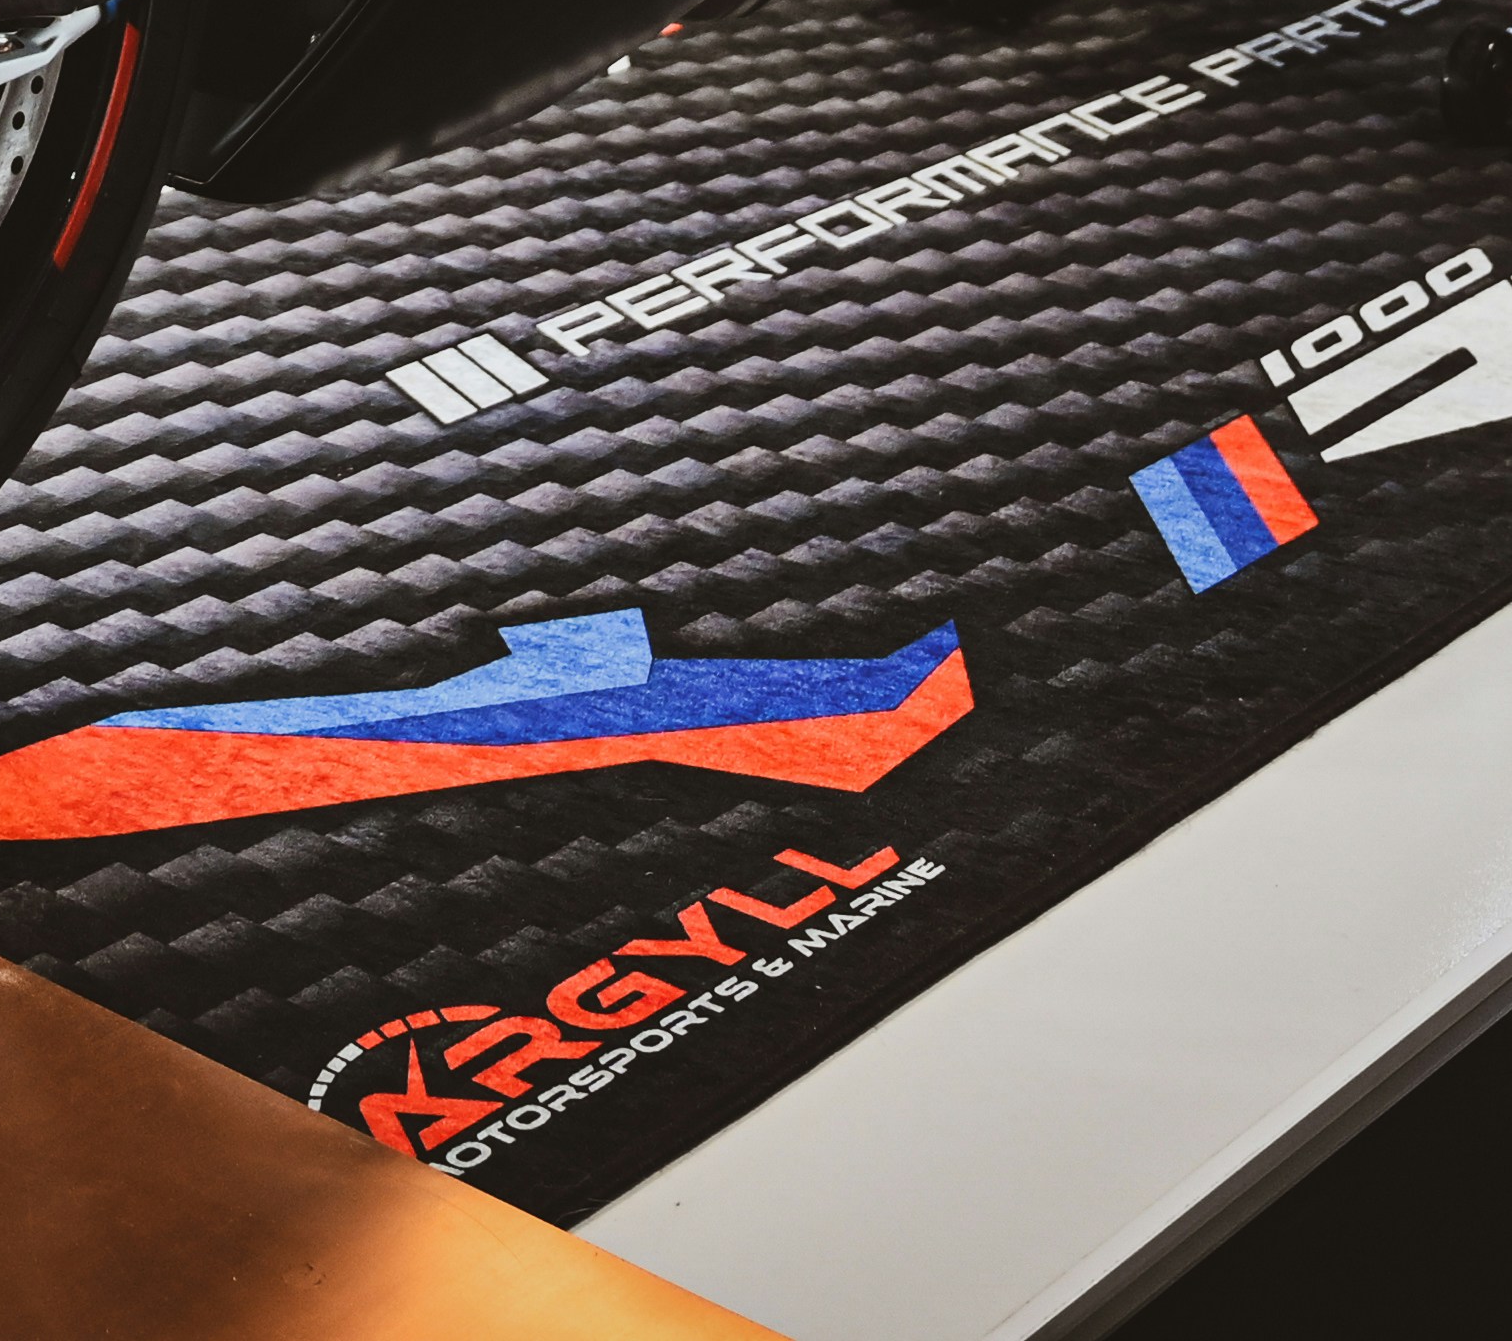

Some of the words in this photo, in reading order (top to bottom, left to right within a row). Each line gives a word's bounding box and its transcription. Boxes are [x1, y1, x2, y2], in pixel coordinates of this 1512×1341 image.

[537, 73, 1205, 356] PERFORMANCE
[1261, 247, 1495, 387] 1000
[359, 846, 901, 1157] ARGYLL
[751, 951, 794, 978] &
[787, 856, 947, 958] MARINE
